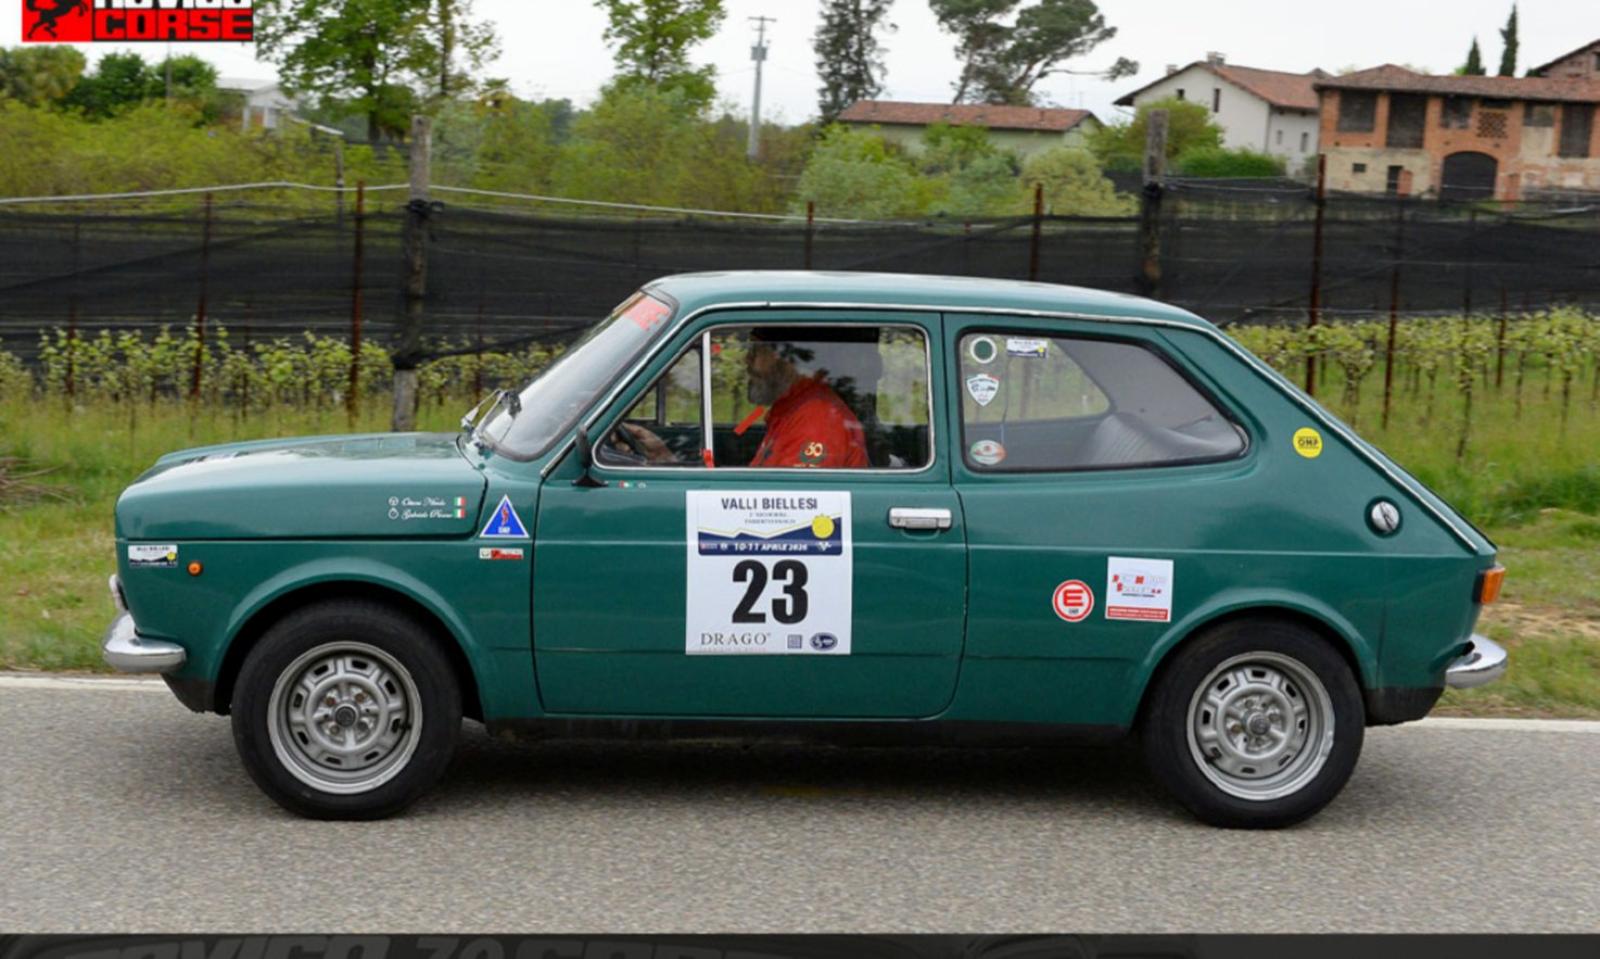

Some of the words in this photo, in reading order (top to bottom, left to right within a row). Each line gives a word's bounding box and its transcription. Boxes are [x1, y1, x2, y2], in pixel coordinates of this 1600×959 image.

[721, 497, 757, 510] VALLI
[762, 497, 818, 510] BIELLESI
[732, 559, 808, 624] 23
[1063, 589, 1084, 606] E
